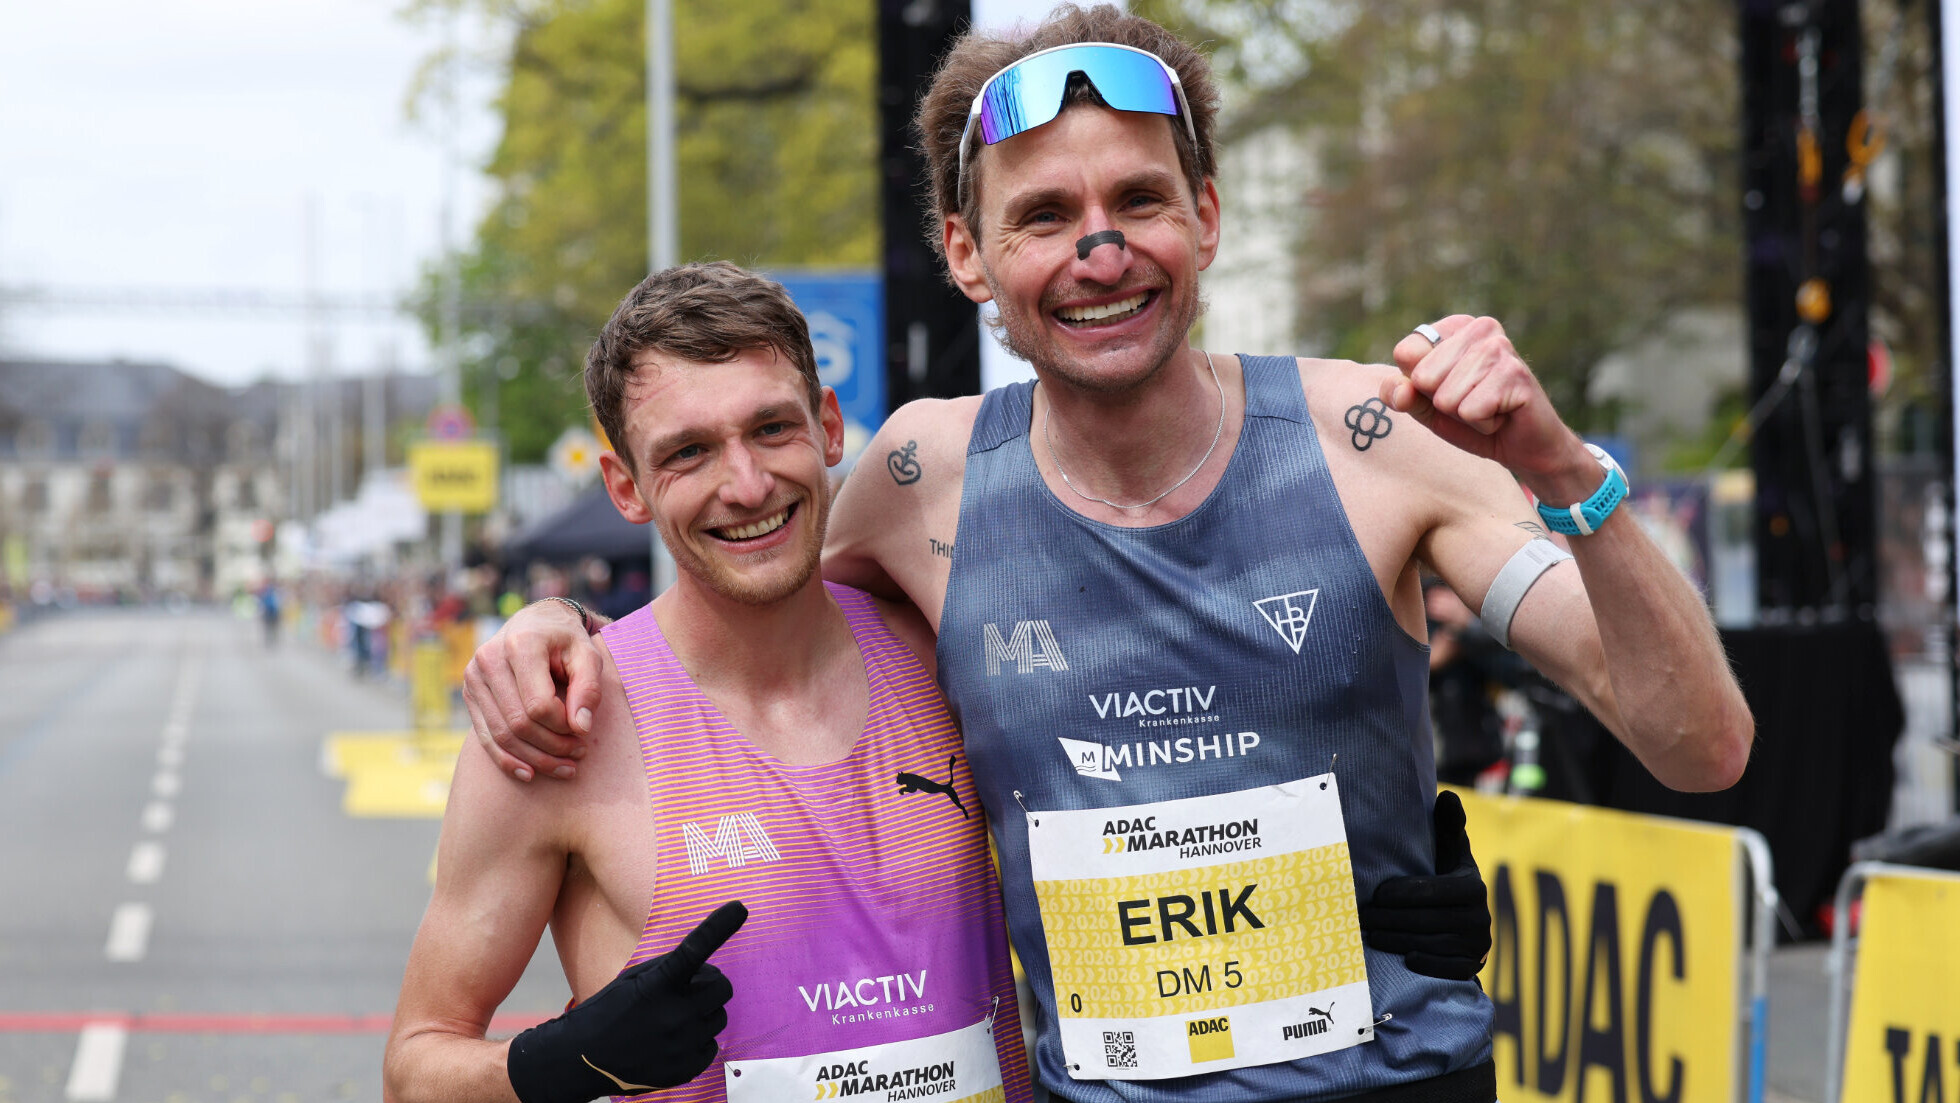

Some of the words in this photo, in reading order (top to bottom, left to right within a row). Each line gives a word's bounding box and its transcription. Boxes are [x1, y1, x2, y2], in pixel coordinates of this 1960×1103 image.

[984, 620, 1069, 676] MA
[1089, 686, 1216, 719] VIACTIV
[1139, 714, 1220, 728] Krankenkasse
[1103, 731, 1261, 770] MINSHIP
[1102, 816, 1157, 836] ADAC
[1127, 818, 1259, 852] MARATHON
[682, 812, 781, 875] MA
[1179, 837, 1262, 859] HANNOVER
[1118, 883, 1265, 945] ERIK
[798, 970, 927, 1012] VIACTIV
[1157, 964, 1213, 998] DM
[1224, 961, 1243, 988] 5
[1493, 860, 1686, 1103] ADAC
[831, 1003, 935, 1025] Krankenkasse
[1071, 993, 1082, 1013] 0
[1188, 1017, 1229, 1036] ADAC
[1282, 1018, 1328, 1040] PUMA
[815, 1060, 869, 1082] ADAC
[839, 1061, 955, 1097] MARATHON
[887, 1080, 956, 1103] HANNOVER
